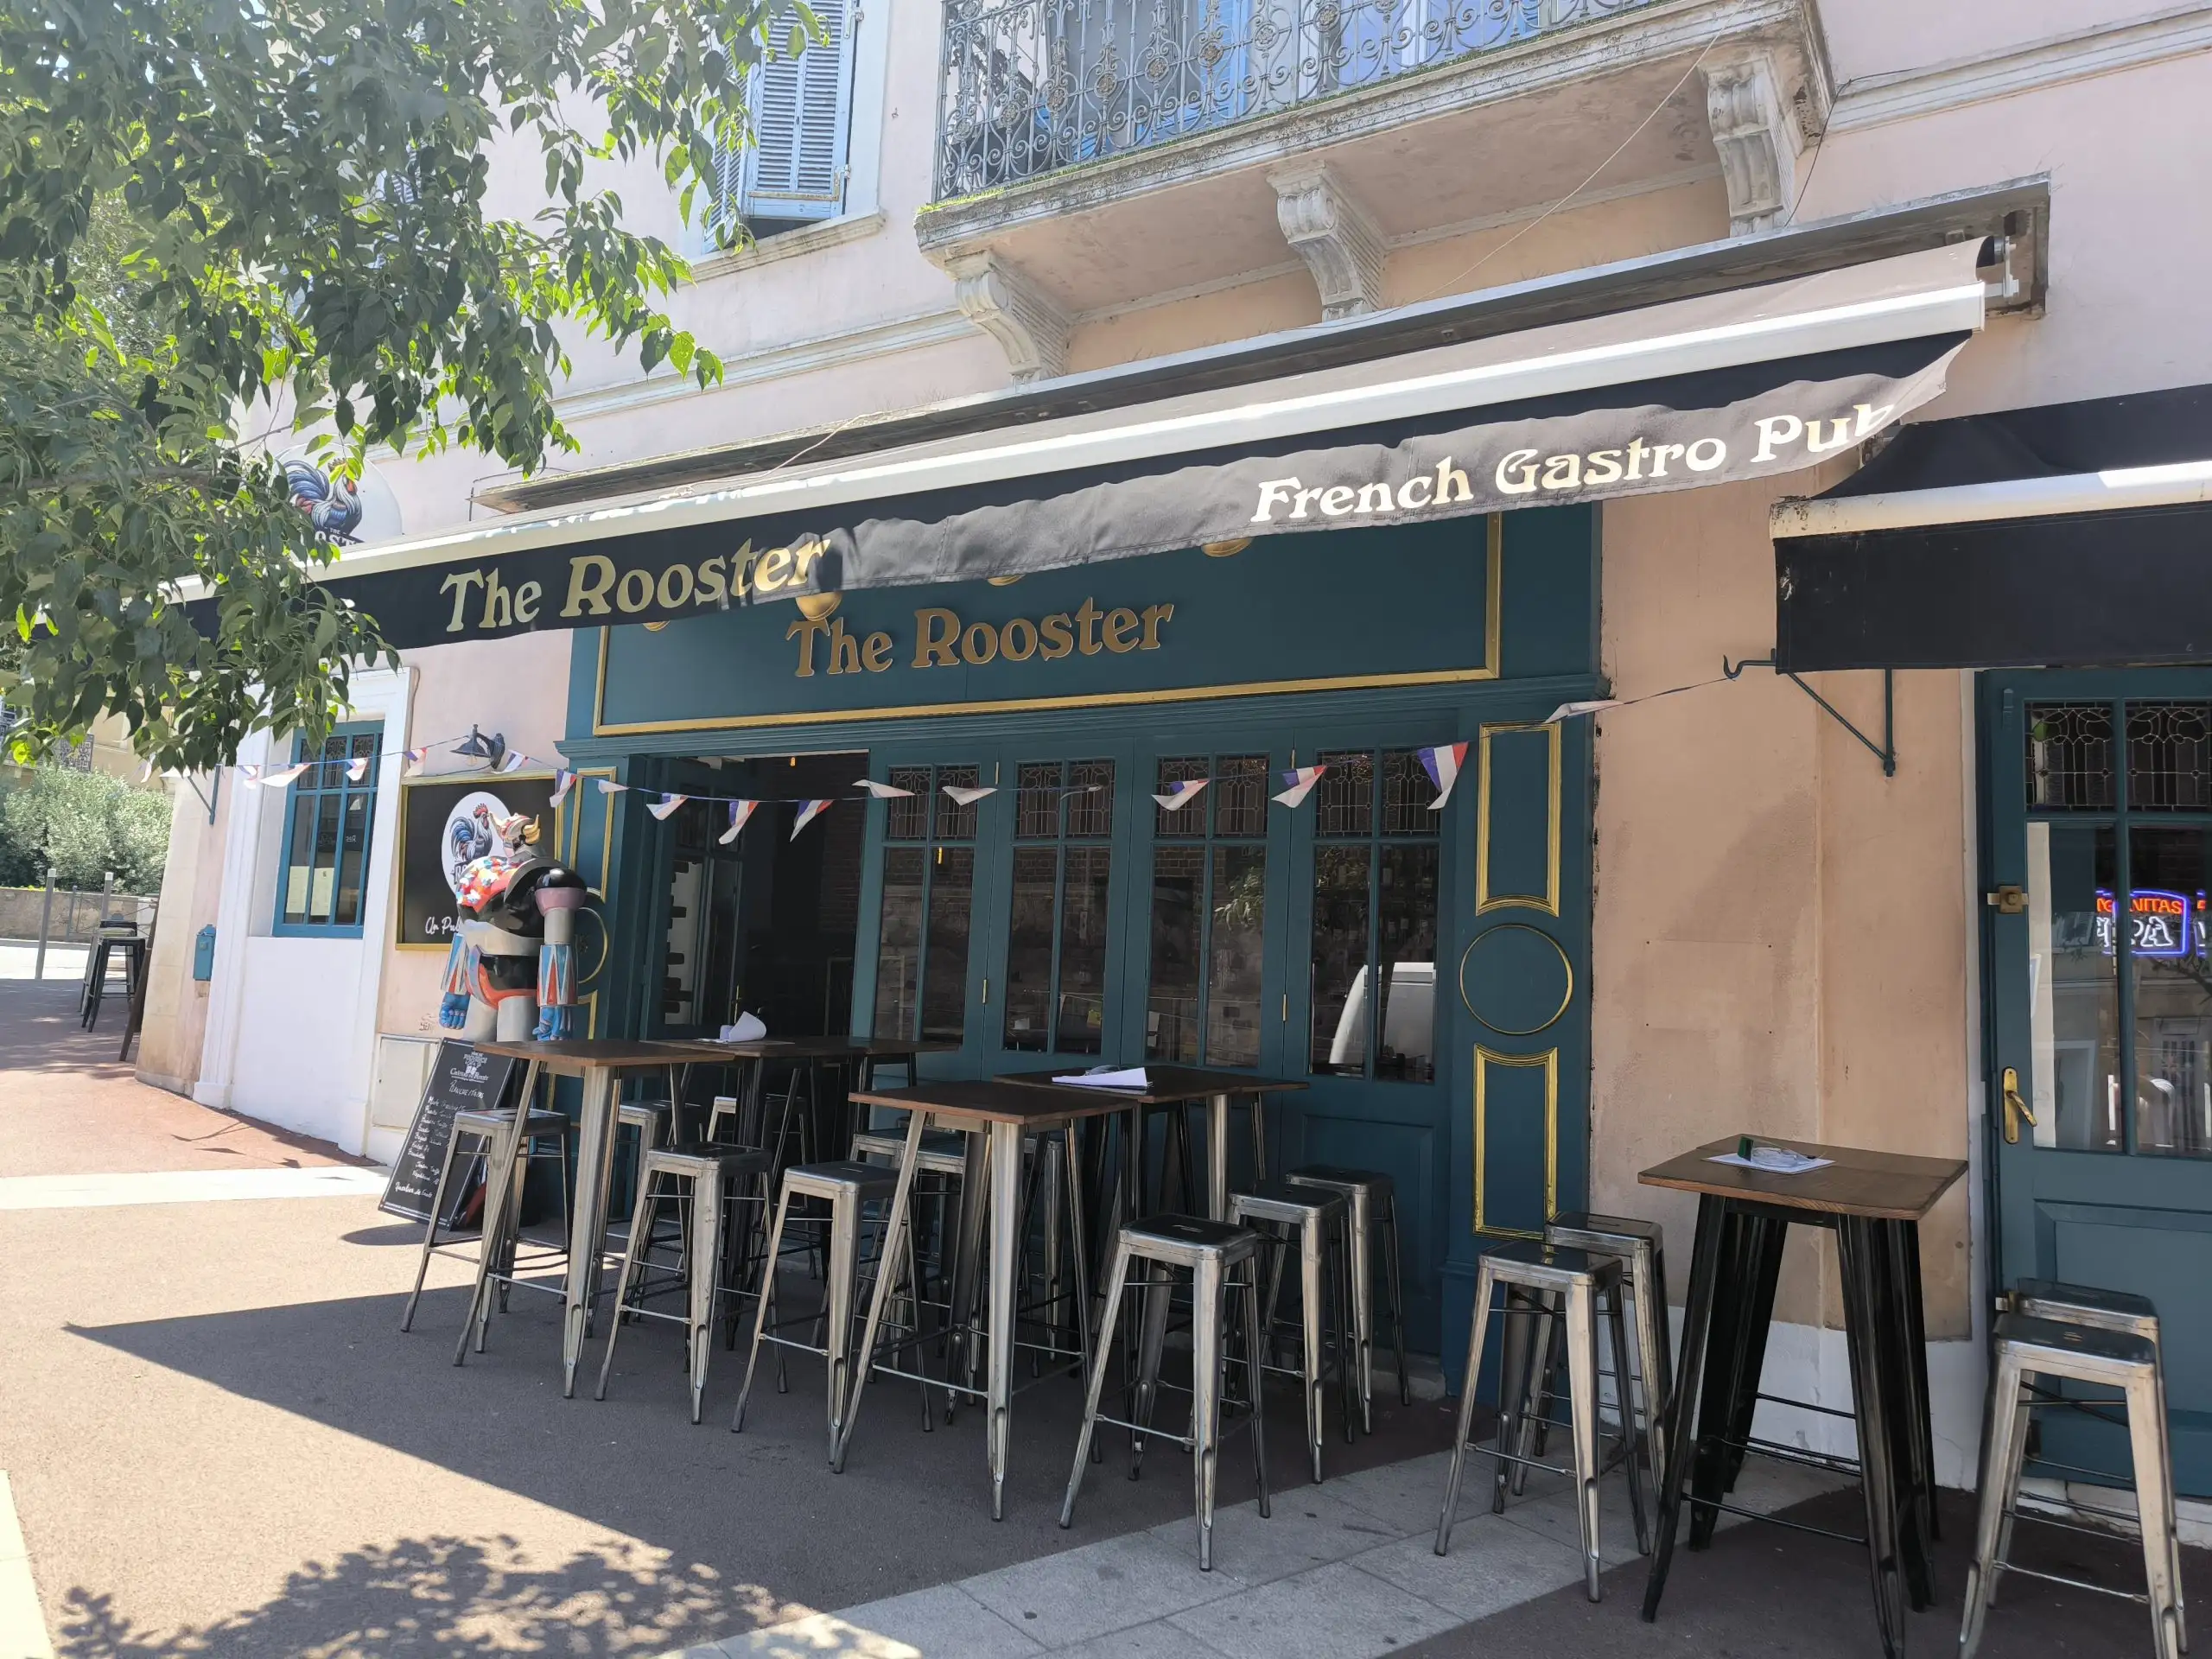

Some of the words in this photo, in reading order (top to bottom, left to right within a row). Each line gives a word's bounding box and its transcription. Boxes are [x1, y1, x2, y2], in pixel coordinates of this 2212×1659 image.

[1250, 457, 1474, 524] French
[1495, 435, 1727, 494] Gastro
[1750, 404, 1895, 463] Pub
[439, 567, 542, 632] The
[559, 537, 831, 618] Rooster
[785, 616, 893, 677] The
[911, 596, 1174, 669] Rooster
